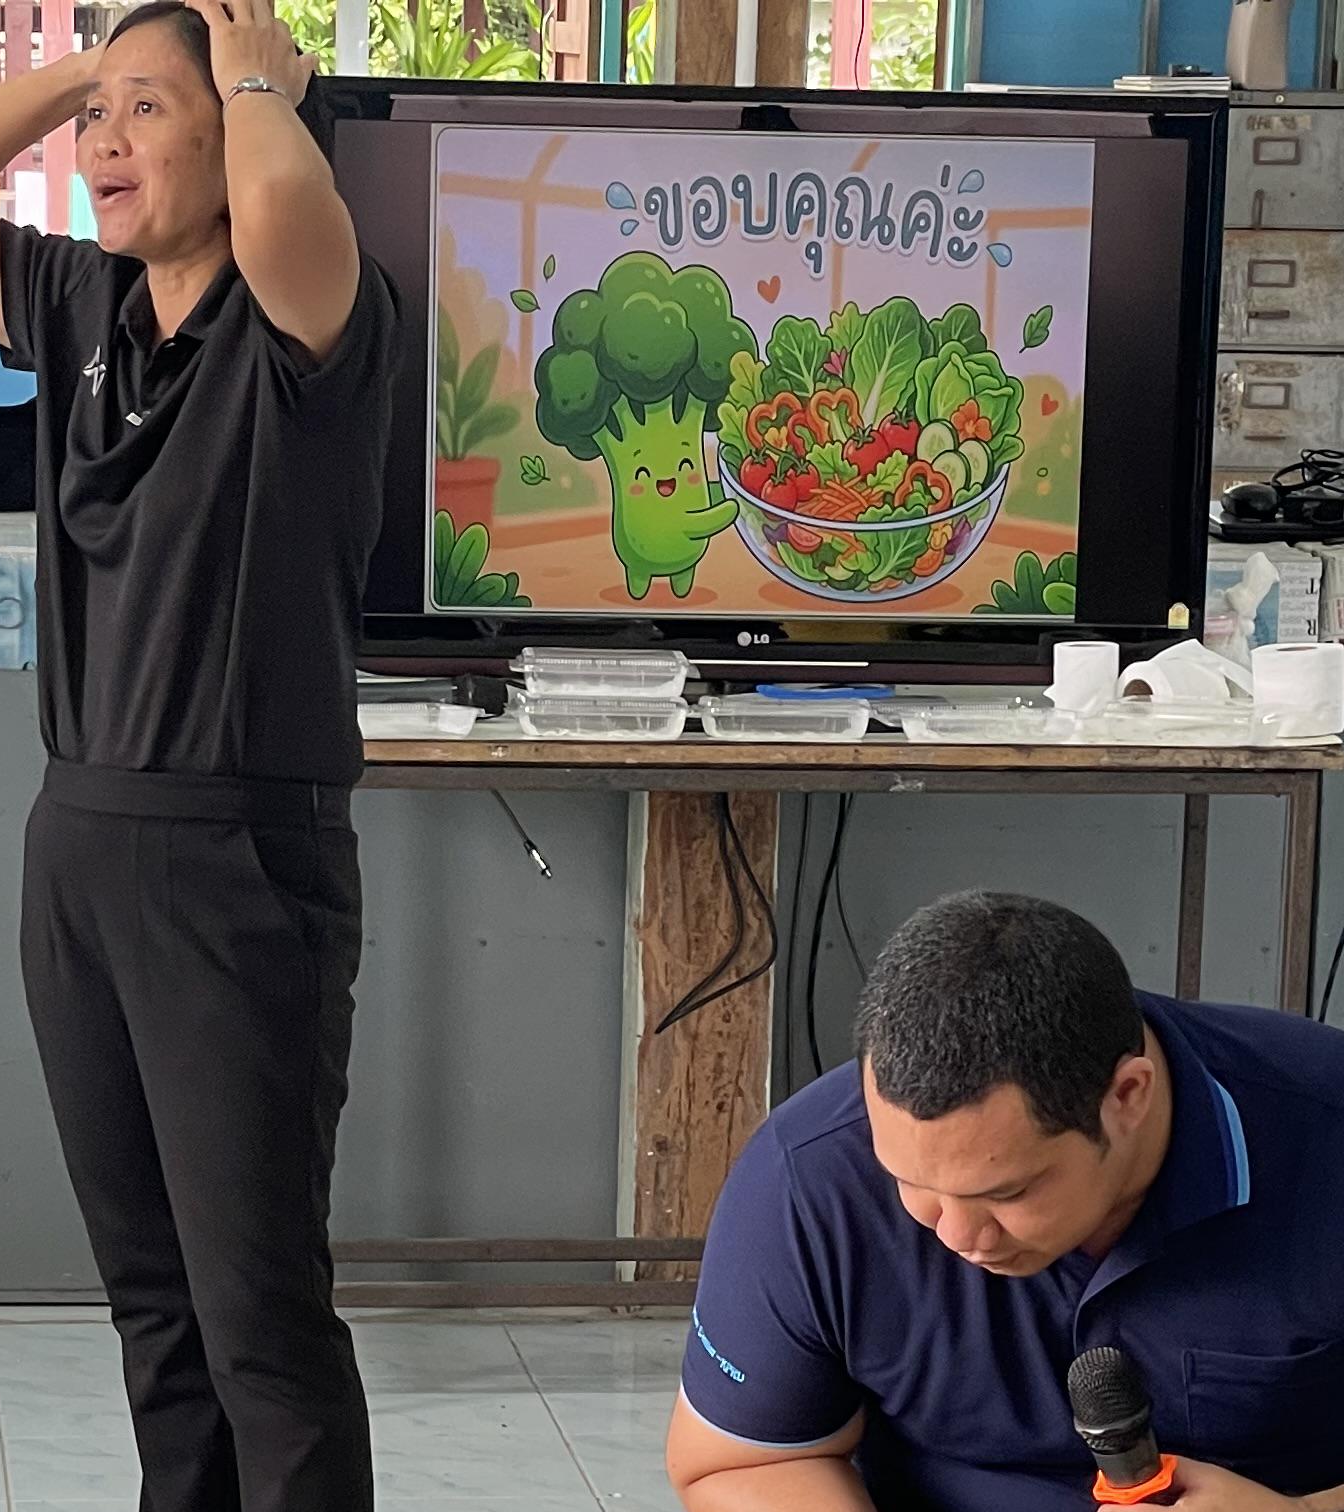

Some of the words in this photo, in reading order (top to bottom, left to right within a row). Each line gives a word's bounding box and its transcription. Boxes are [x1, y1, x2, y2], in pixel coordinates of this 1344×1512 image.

[644, 164, 984, 274] ขอบคุณค่ะ
[753, 633, 770, 644] LG
